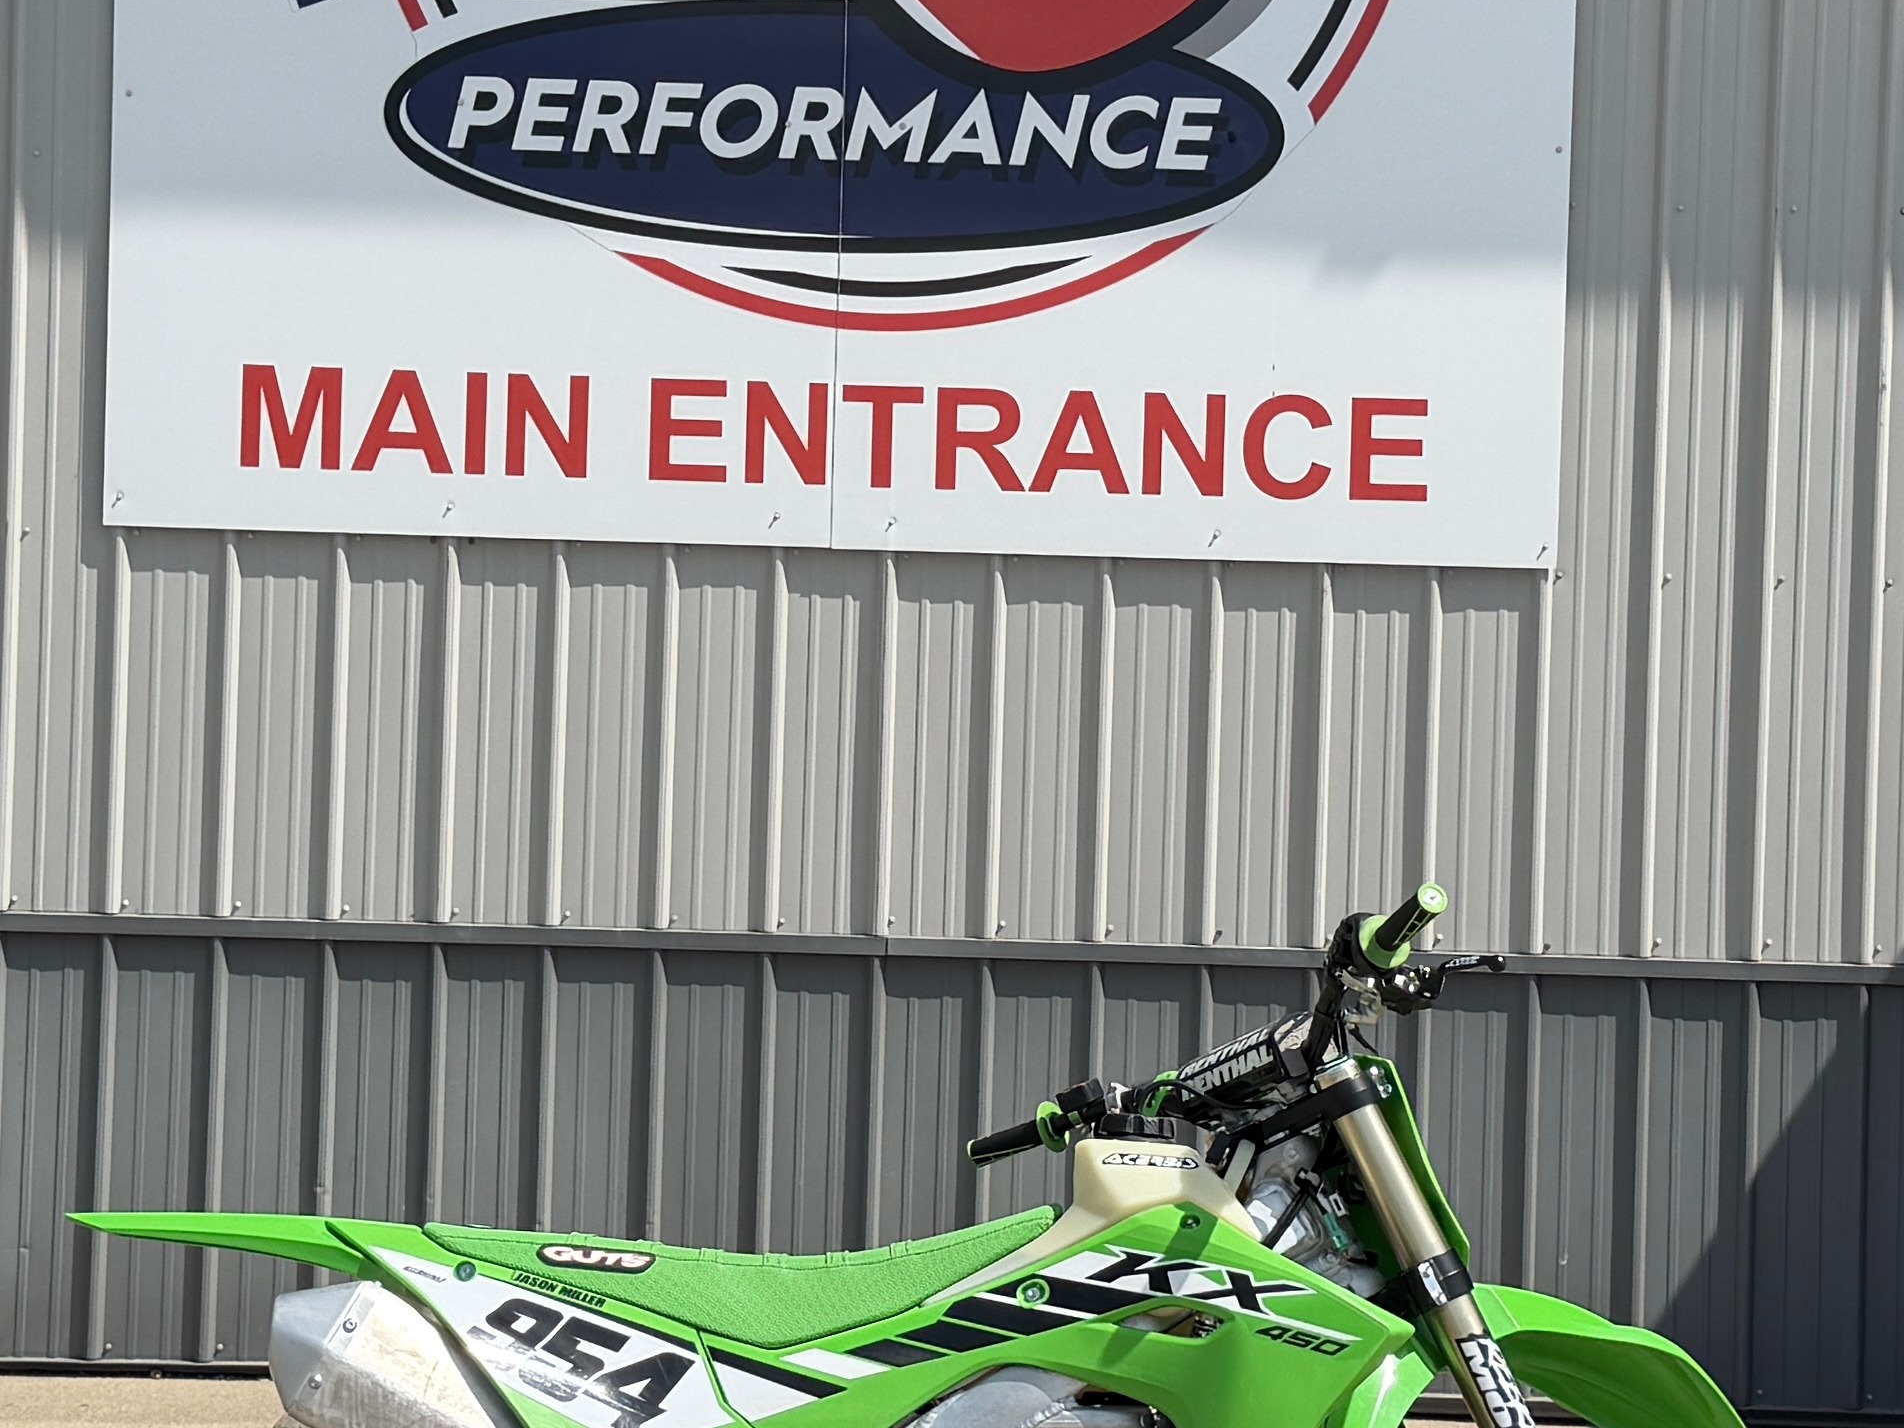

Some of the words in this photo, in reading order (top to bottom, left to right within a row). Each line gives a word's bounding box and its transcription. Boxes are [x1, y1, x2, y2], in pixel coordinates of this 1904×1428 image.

[447, 77, 1222, 172] PERFORMANCE
[242, 365, 590, 478] MAIN
[649, 380, 1429, 502] ENTRANCE
[542, 1245, 653, 1269] GUTS
[1084, 1248, 1315, 1316] KX
[513, 1270, 558, 1293] JASON
[558, 1283, 607, 1309] MILLER
[1253, 1324, 1351, 1356] 450
